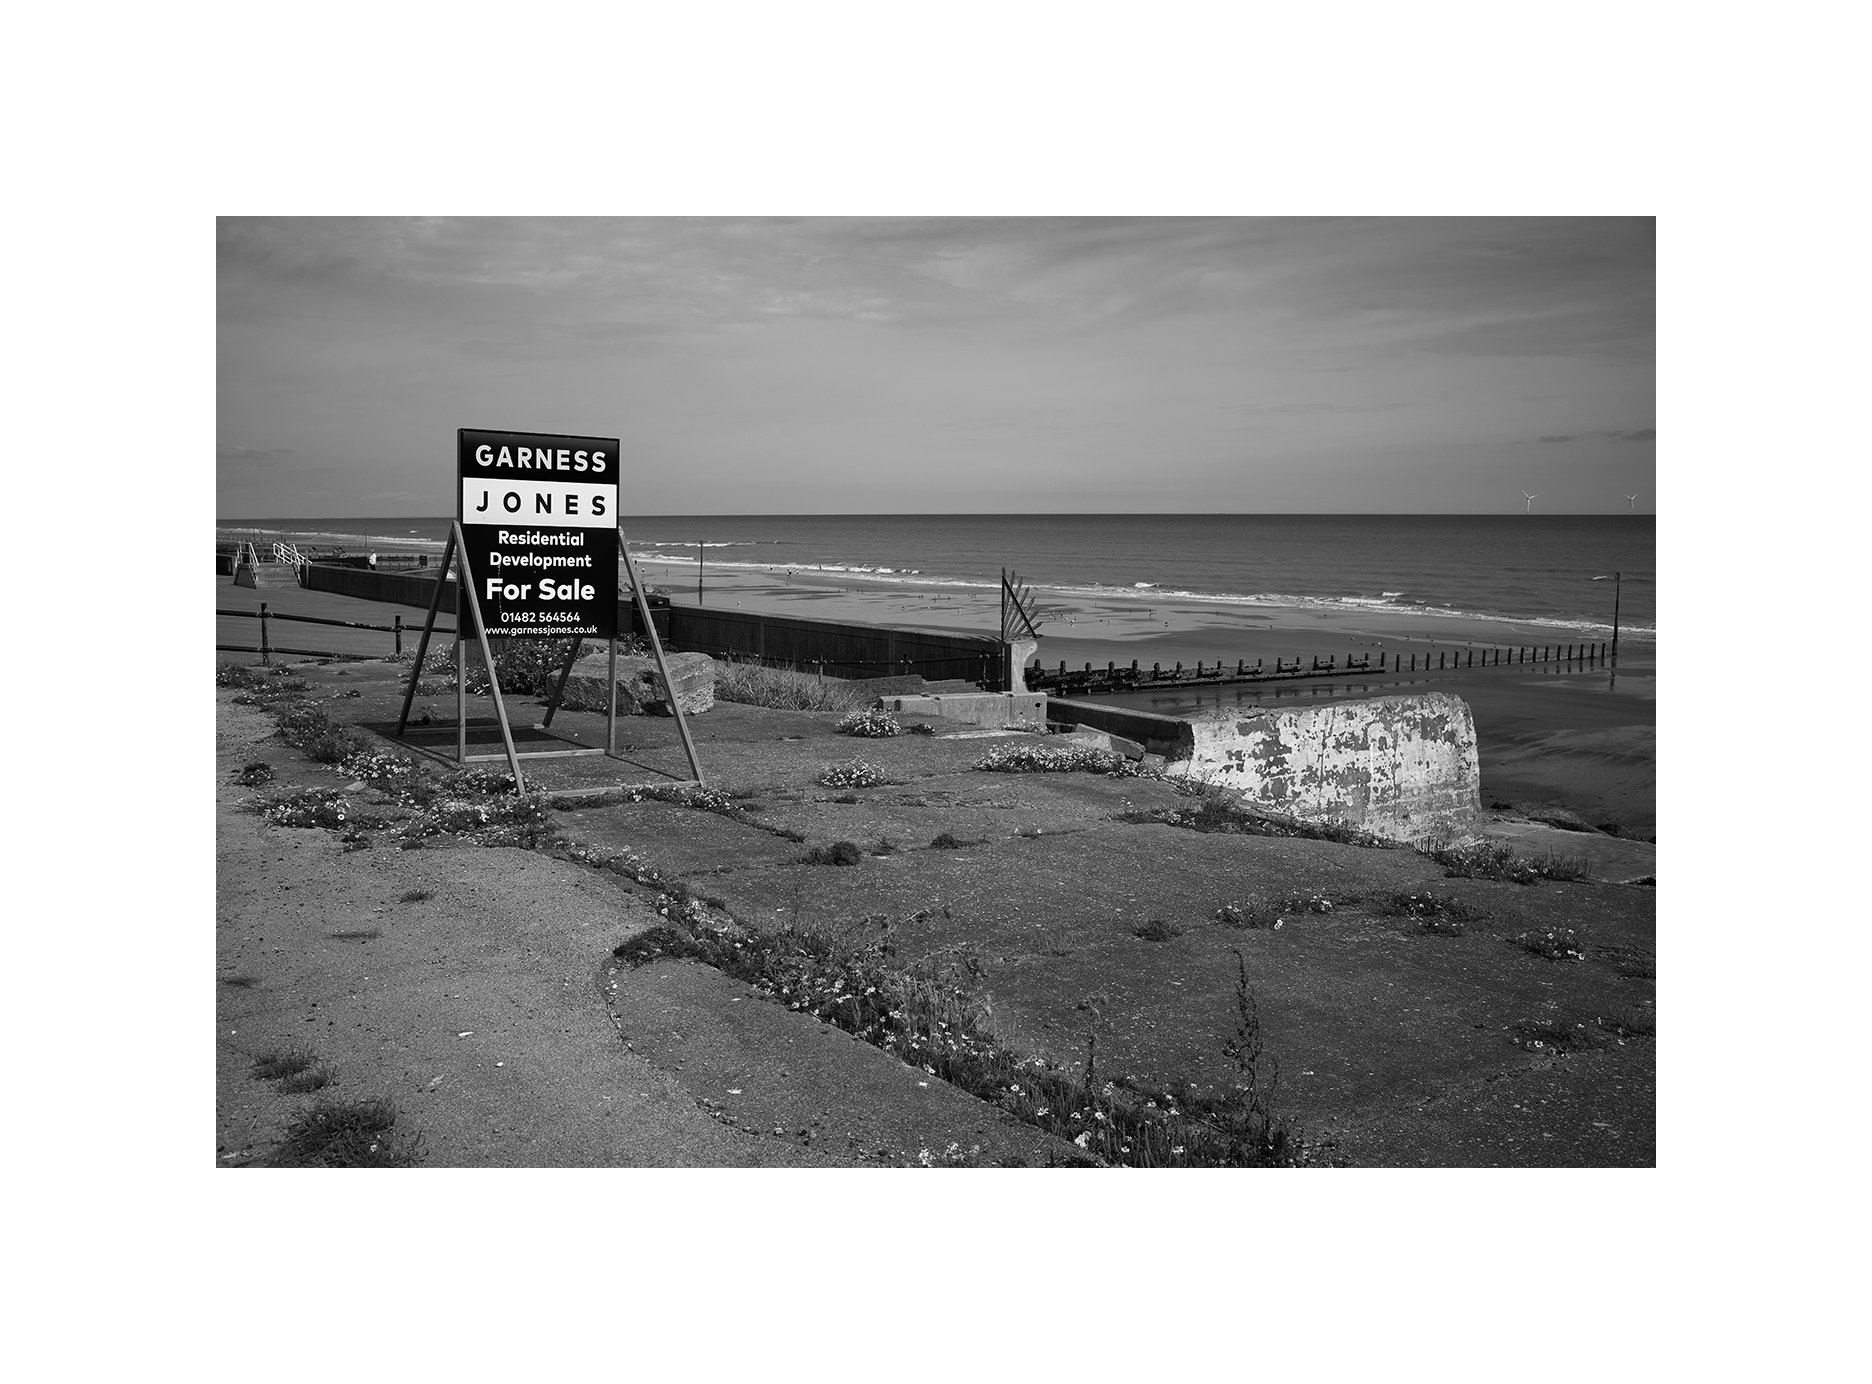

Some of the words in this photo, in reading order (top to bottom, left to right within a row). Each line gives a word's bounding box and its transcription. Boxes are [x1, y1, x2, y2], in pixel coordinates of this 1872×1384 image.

[476, 444, 606, 473] GARNESS
[476, 490, 606, 516] JONES
[498, 530, 584, 546] Residential
[489, 552, 592, 570] Development
[486, 578, 531, 601] For
[538, 578, 595, 601] Sale
[501, 611, 536, 623] 01482
[538, 611, 580, 623] 564564
[484, 624, 598, 637] www.garnessjones.co.uk
